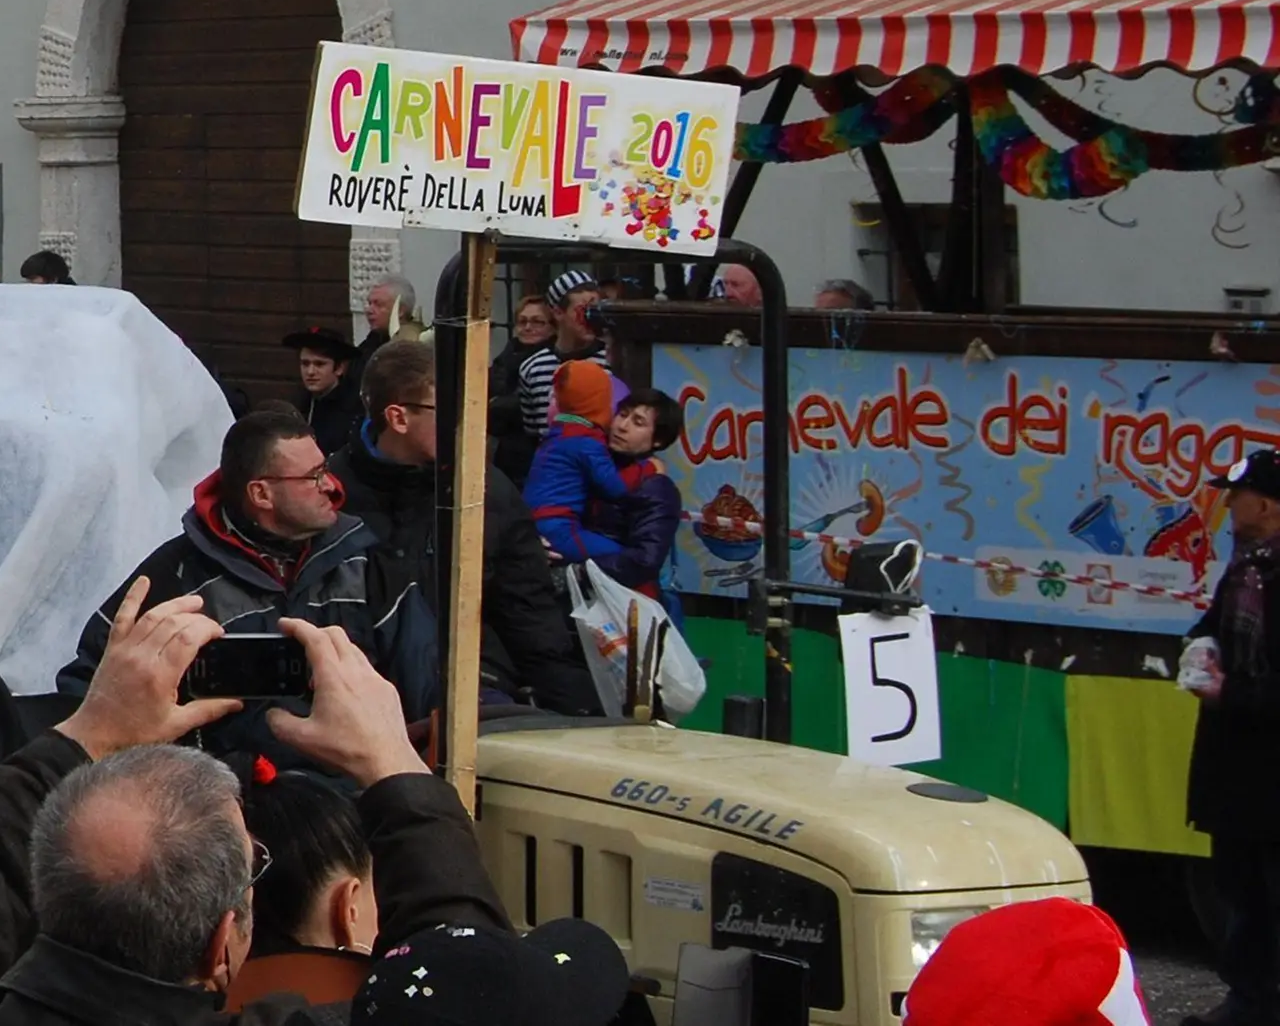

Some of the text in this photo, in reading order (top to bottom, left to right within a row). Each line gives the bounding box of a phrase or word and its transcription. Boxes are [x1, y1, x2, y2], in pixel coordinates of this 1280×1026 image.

[330, 63, 718, 218] CARNEVALE 2016
[329, 163, 547, 218] ROVERÈ DELLA LUNA
[980, 371, 1068, 456] dei
[869, 632, 918, 743] 5
[700, 797, 804, 841] AGILE
[714, 902, 825, 948] Lamborghini
